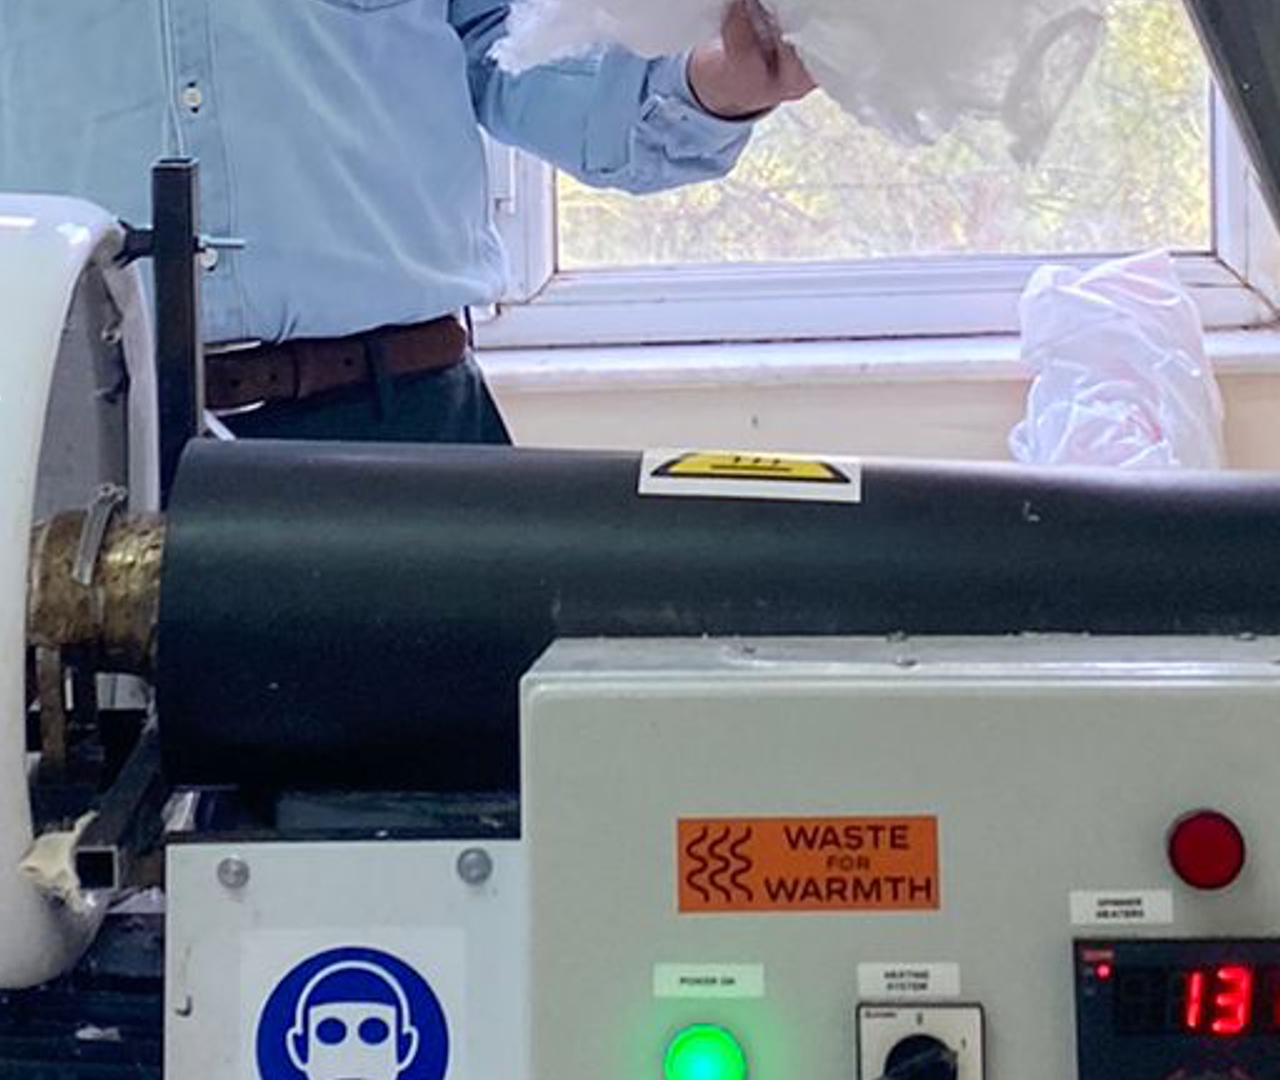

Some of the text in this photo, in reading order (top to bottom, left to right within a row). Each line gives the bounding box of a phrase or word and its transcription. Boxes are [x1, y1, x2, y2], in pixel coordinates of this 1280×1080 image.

[784, 824, 910, 851] WASTE
[826, 854, 871, 871] FOR
[764, 875, 932, 903] WARMTH
